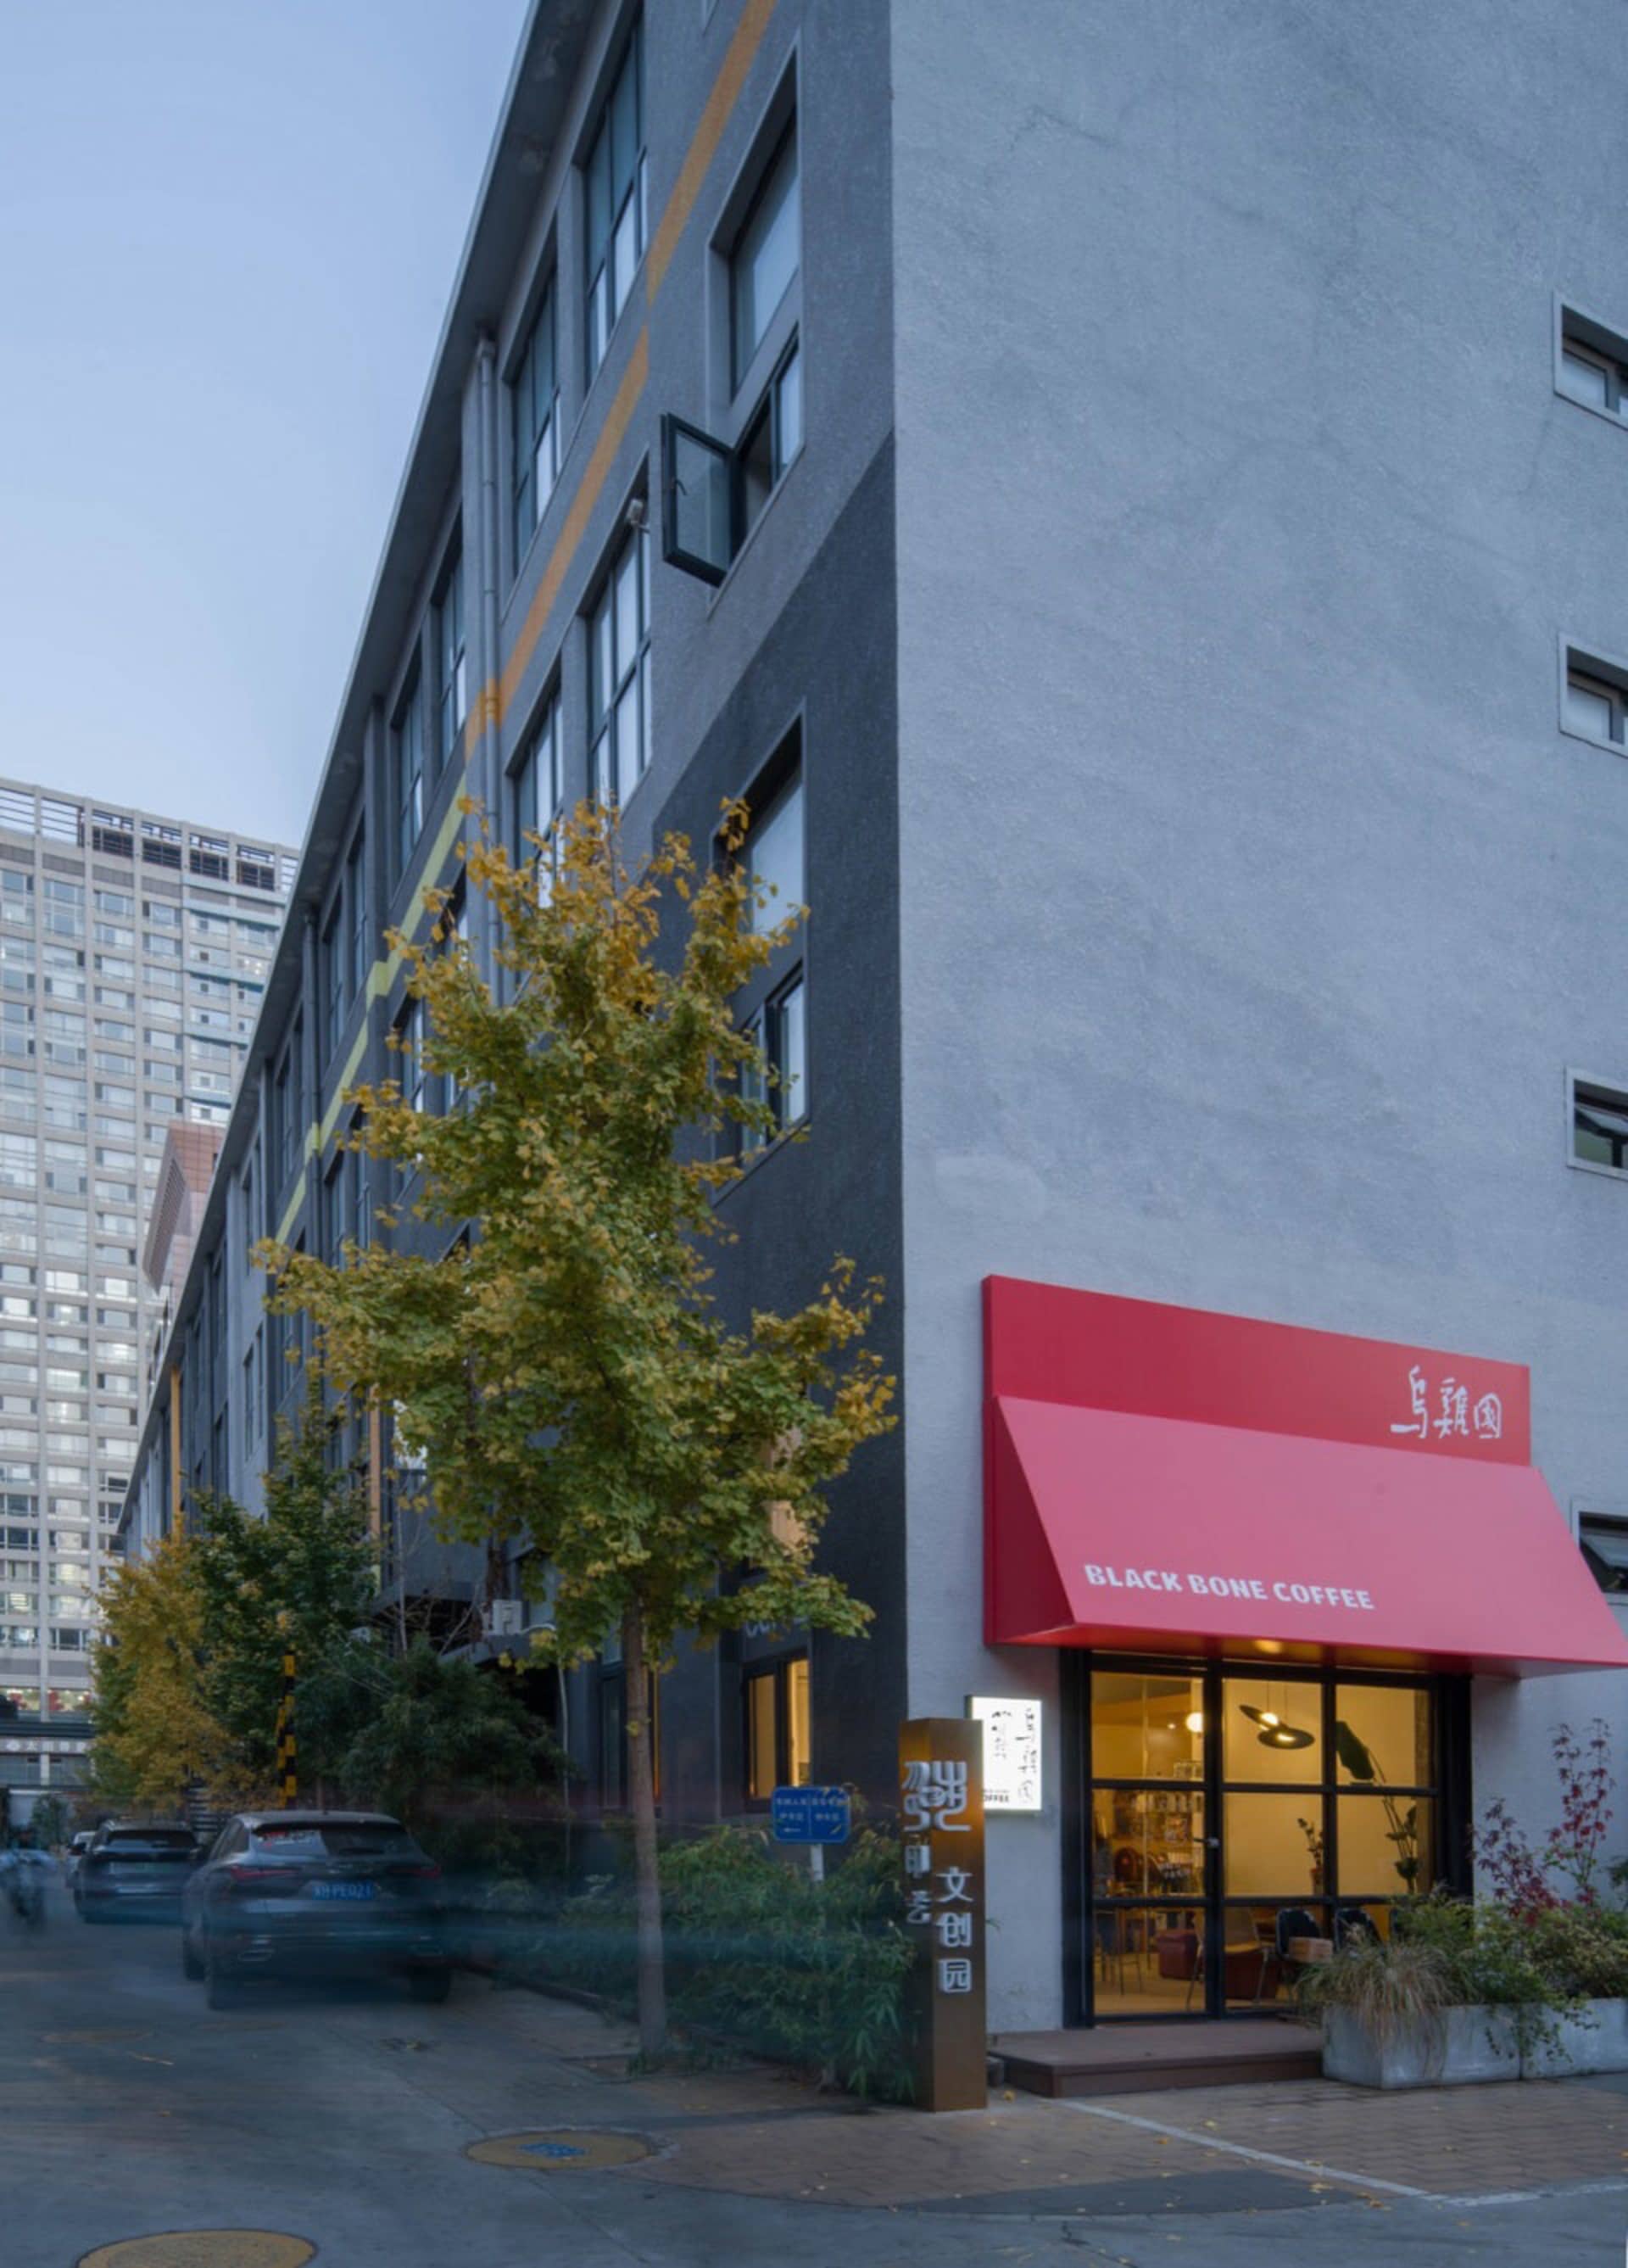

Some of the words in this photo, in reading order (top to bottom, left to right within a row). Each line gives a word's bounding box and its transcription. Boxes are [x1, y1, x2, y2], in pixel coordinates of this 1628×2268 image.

[1084, 1564, 1183, 1592] BLACK
[1188, 1573, 1268, 1600] BONE
[1272, 1582, 1374, 1609] COFFEE
[935, 1866, 974, 1993] 文创园
